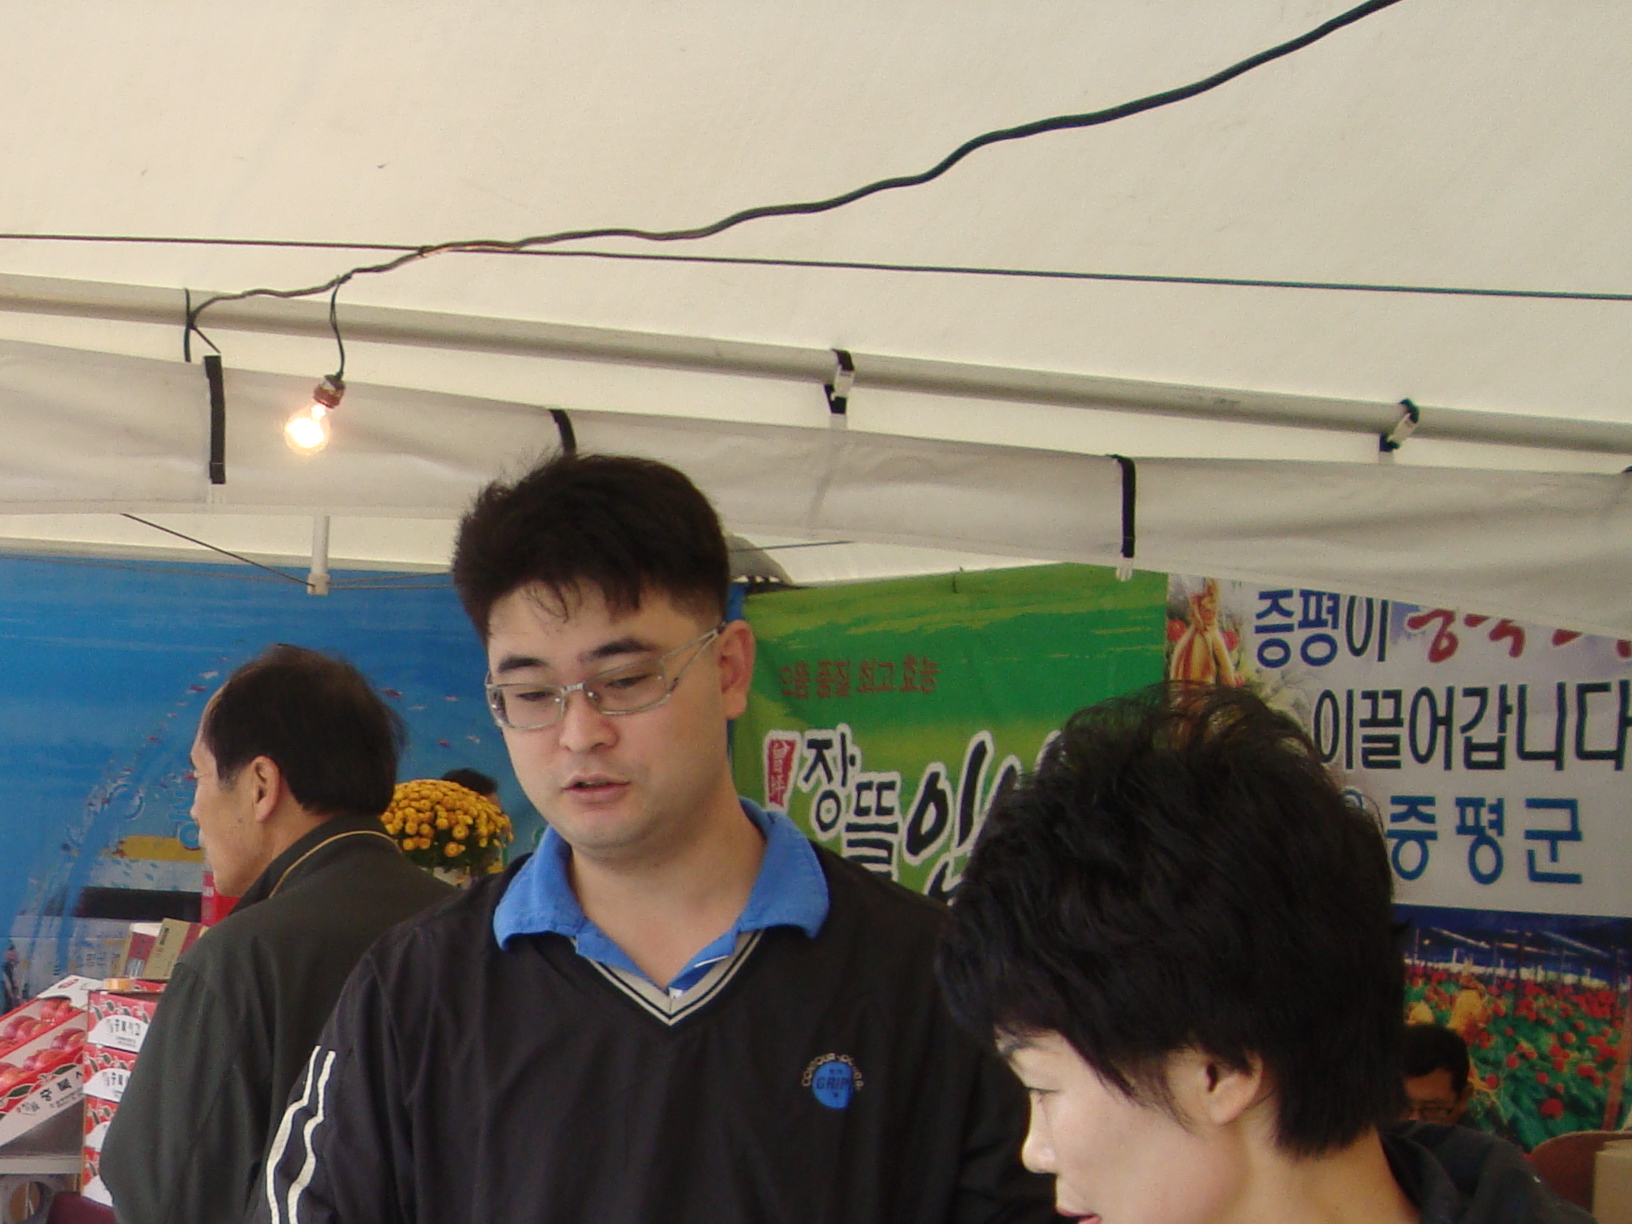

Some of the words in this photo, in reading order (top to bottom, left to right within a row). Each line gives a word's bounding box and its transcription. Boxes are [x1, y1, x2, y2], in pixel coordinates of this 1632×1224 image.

[1253, 588, 1389, 668] 증평이
[780, 662, 810, 698] 으뜸
[816, 660, 851, 697] 품질
[857, 658, 895, 694] 최고
[899, 653, 940, 694] 효능
[1314, 680, 1632, 771] 이끌어갑니다
[1386, 795, 1583, 886] 증평군
